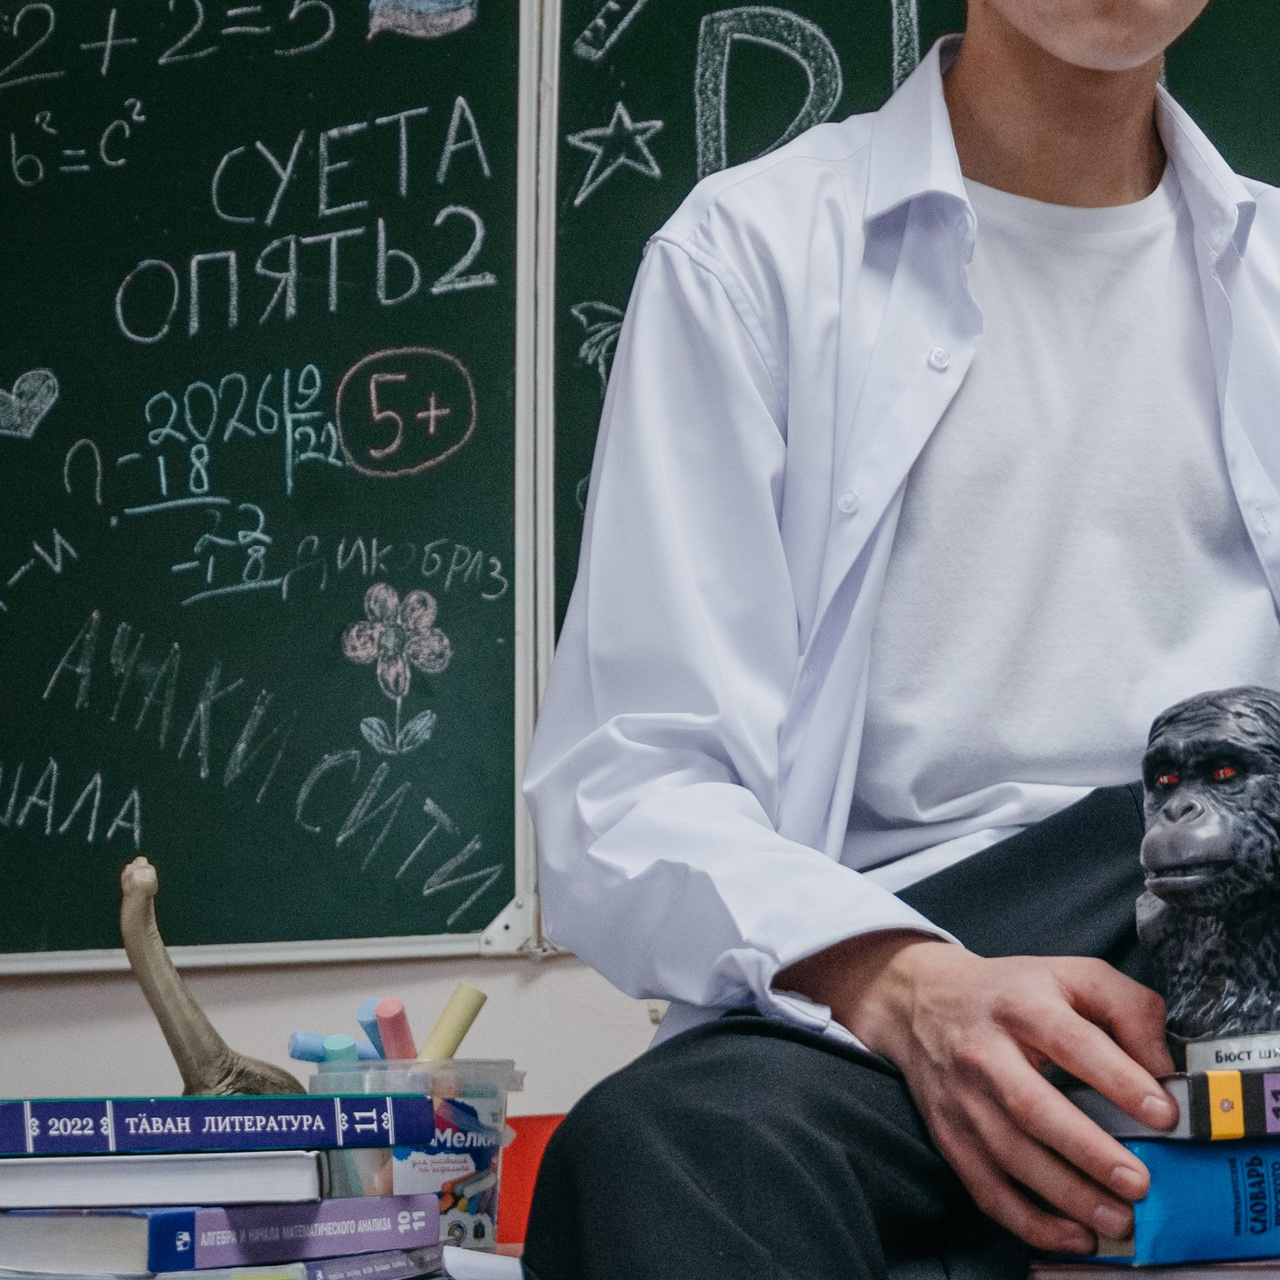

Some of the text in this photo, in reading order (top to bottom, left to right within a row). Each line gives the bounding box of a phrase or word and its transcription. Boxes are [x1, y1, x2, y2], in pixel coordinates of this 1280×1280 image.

[212, 96, 491, 226] СУЕТА
[1215, 1049, 1252, 1064] Бюст
[49, 1118, 94, 1136] 2022
[203, 1114, 325, 1133] ЛИТЕРАТУРА
[354, 1108, 377, 1133] 11
[1245, 1155, 1268, 1234] СЛОВАРЬ
[200, 1230, 237, 1246] АЛГЕБРА
[240, 1231, 247, 1243] И
[249, 1228, 281, 1243] НАЧАЛА
[283, 1220, 355, 1239] МАТЕМАТИЧЕСКОГО
[358, 1217, 392, 1233] АНАЛИЗА
